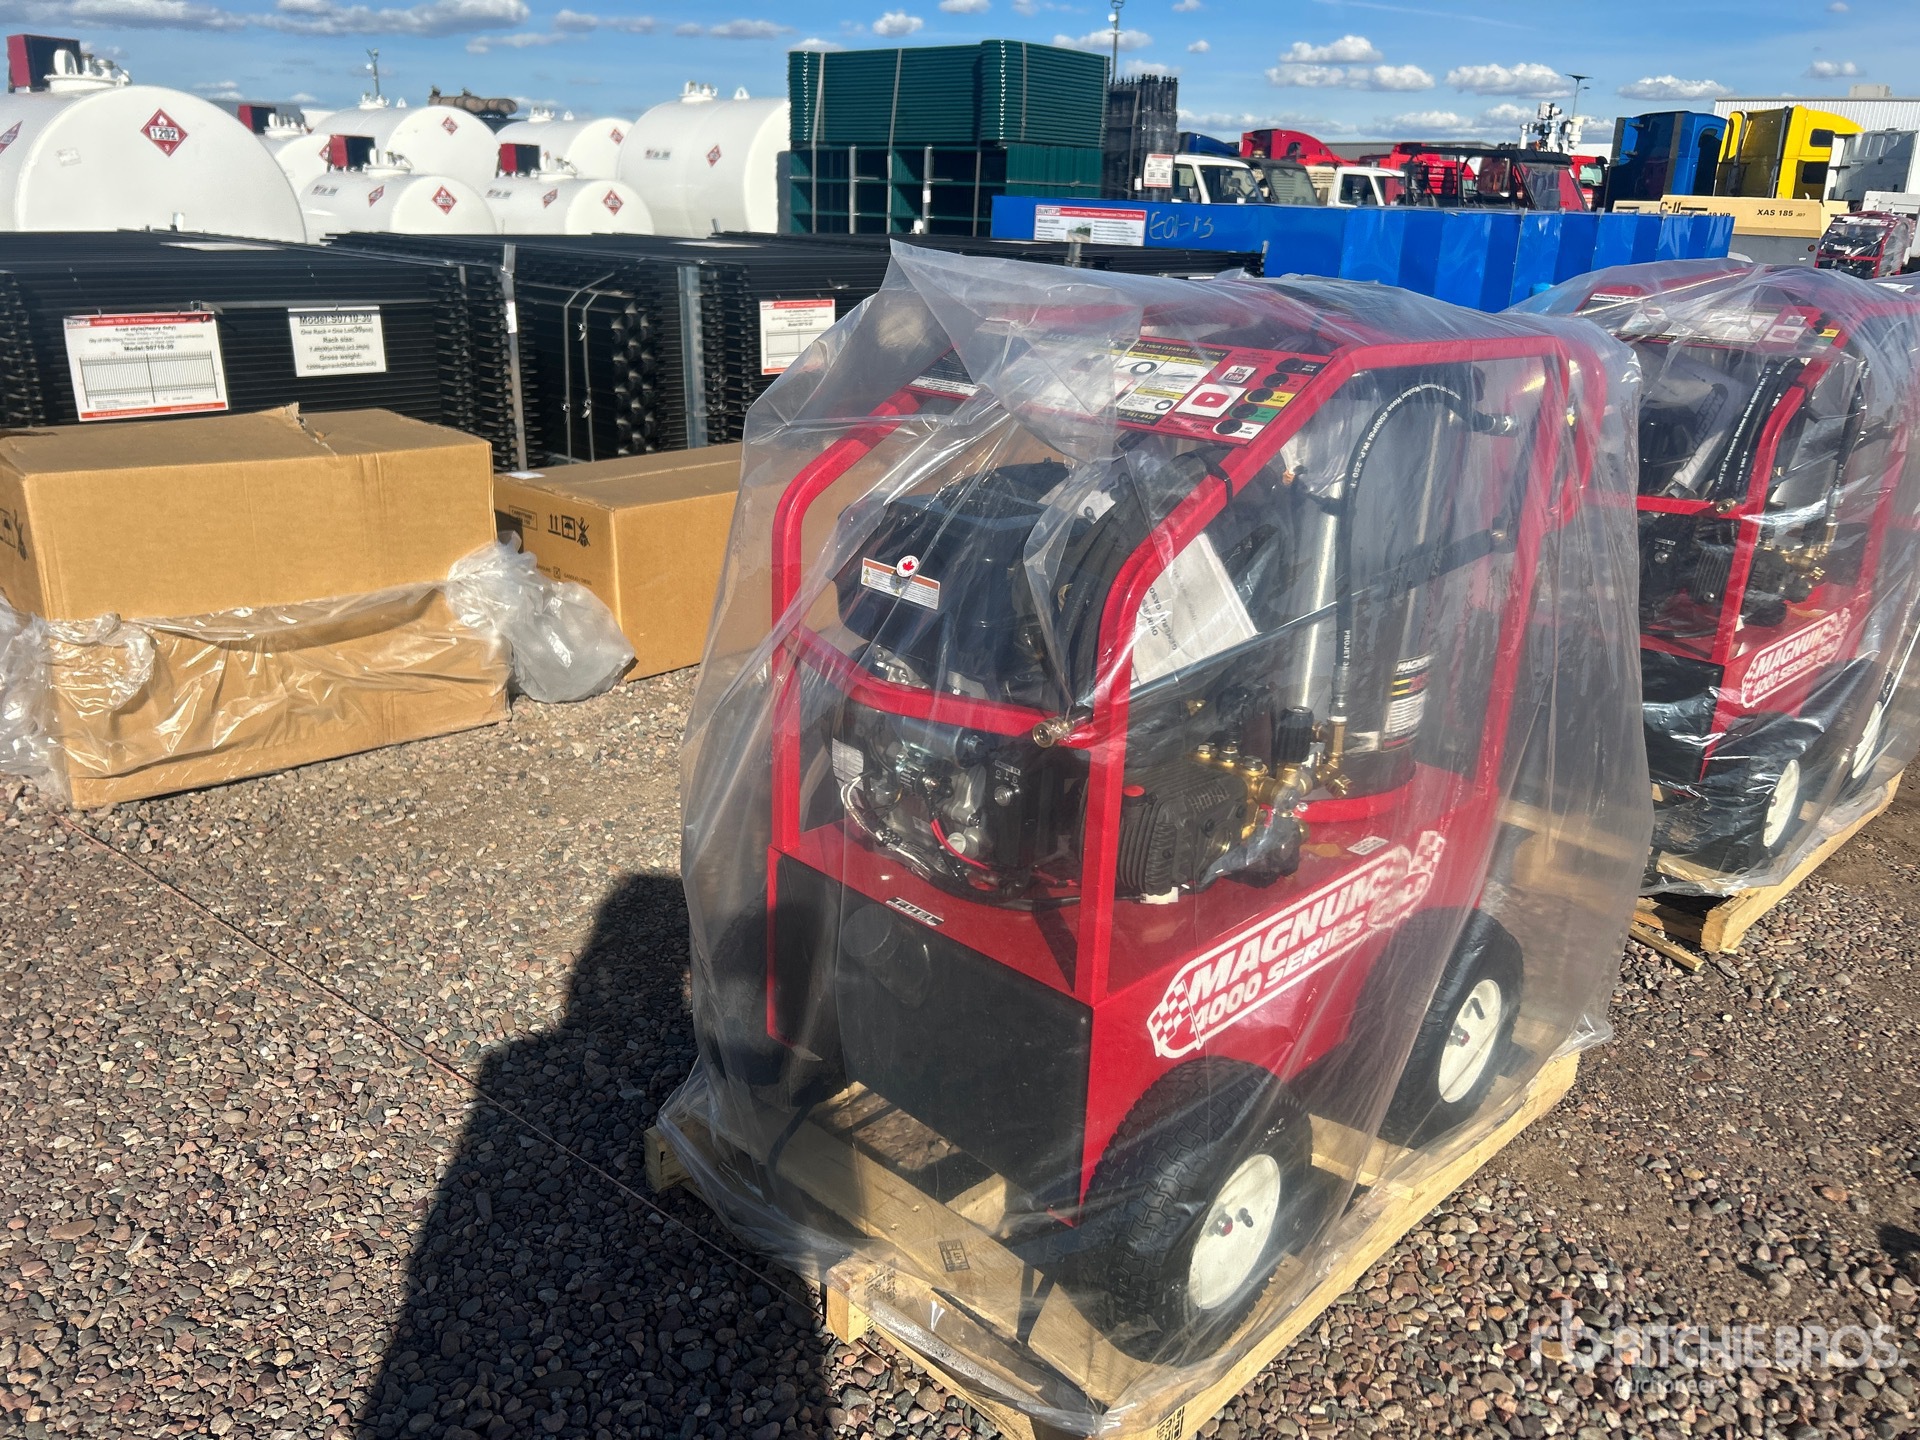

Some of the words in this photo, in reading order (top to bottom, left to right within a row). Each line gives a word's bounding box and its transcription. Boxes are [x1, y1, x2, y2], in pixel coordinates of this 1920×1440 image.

[152, 127, 177, 141] 1202
[1779, 209, 1794, 217] 185
[1387, 396, 1402, 411] Hose
[1186, 864, 1397, 1006] MAGNUM
[1190, 973, 1263, 1033] 4000
[1264, 910, 1367, 989] SERIES
